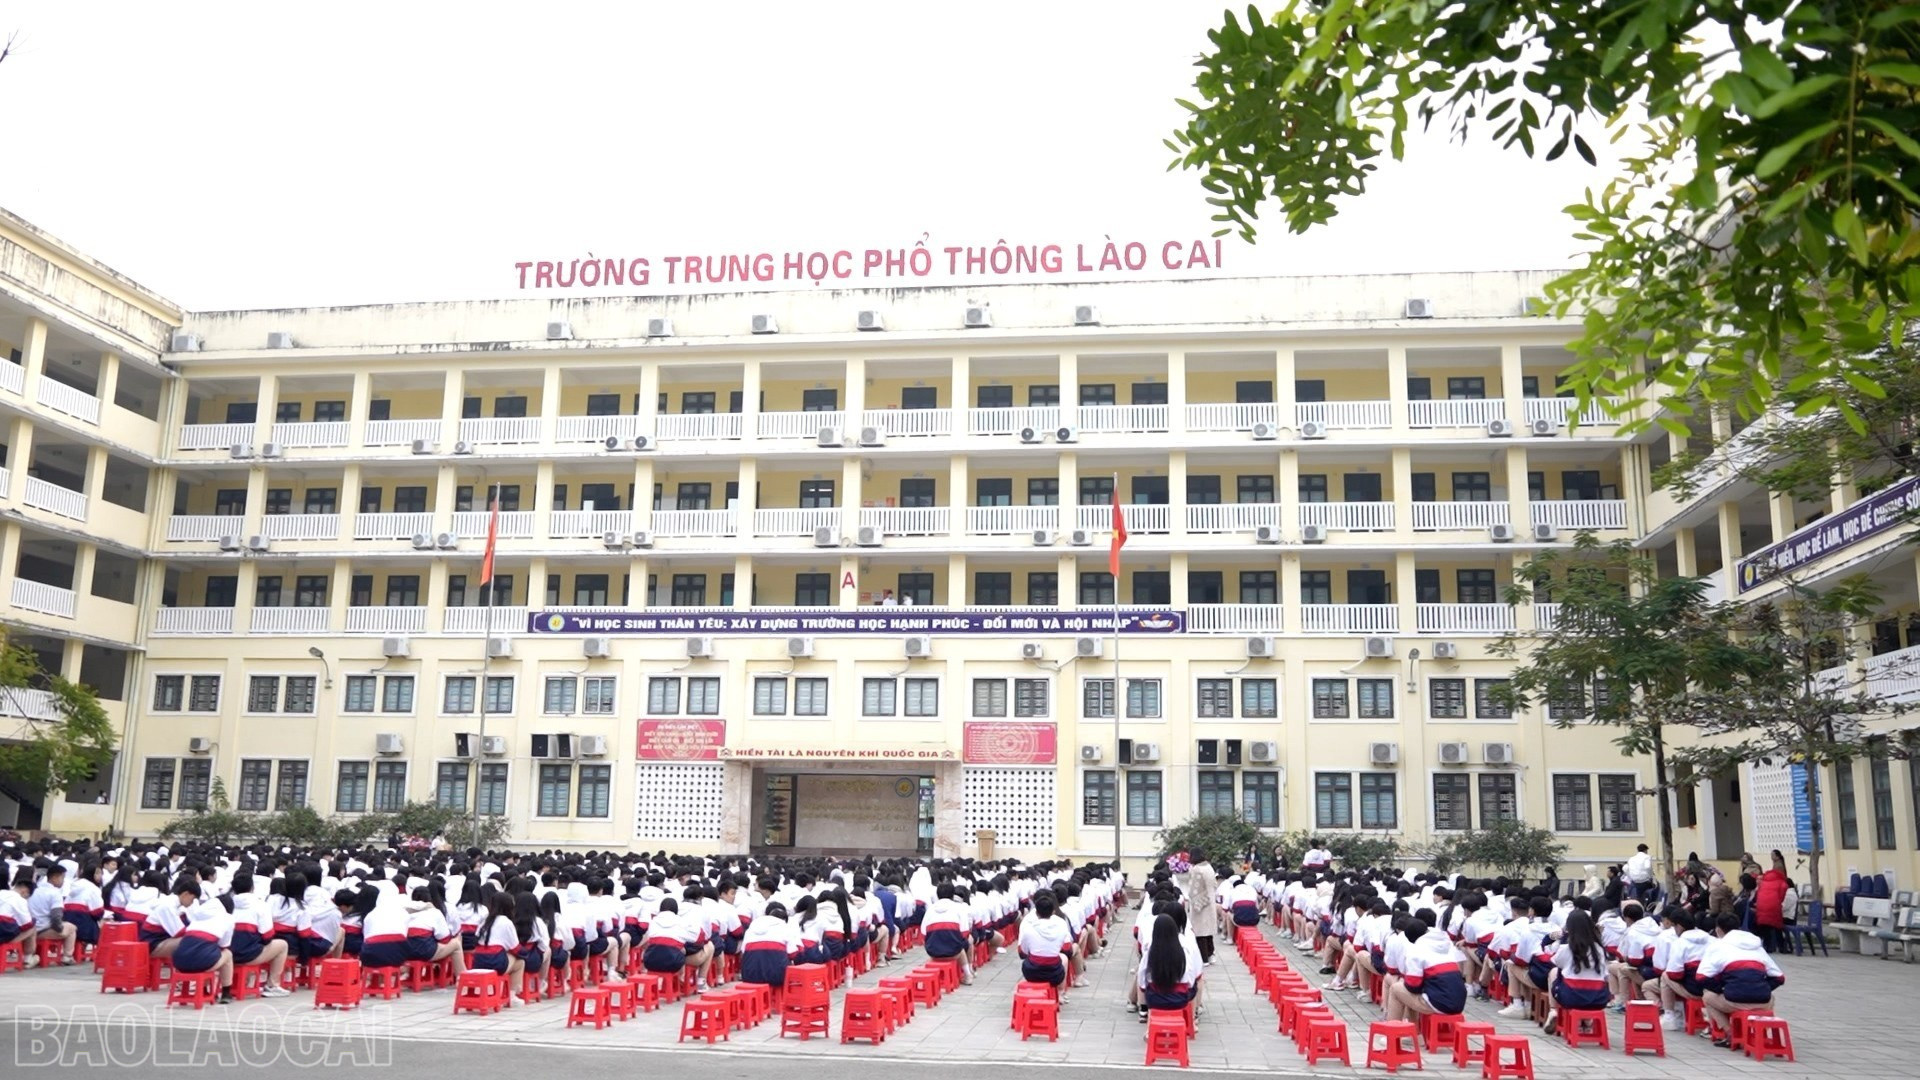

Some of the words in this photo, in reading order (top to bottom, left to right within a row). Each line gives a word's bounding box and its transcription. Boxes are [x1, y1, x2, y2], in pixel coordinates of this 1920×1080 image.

[515, 251, 649, 289] TRƯỜNG
[664, 253, 774, 284] TRUNG
[784, 250, 852, 287] HỌC
[864, 232, 932, 277] PHỔ
[944, 238, 1062, 275] THÔNG
[1077, 234, 1147, 271] LÀO
[1161, 239, 1222, 270] CAI
[1842, 517, 1860, 541] HỌC
[842, 571, 855, 588] A
[594, 619, 621, 631] HỌC
[624, 619, 657, 629] SINH
[660, 617, 695, 629] THÂN
[698, 617, 728, 629] YÊU:
[731, 617, 758, 629] XÂY
[760, 618, 798, 631] DỰNG
[802, 616, 856, 629] TRƯỜNG
[858, 619, 887, 631] HỌC
[890, 619, 929, 631] HẠNH
[932, 617, 970, 629] PHÚC
[1010, 617, 1039, 629] MỚI
[1042, 617, 1060, 629] VÀ
[1063, 617, 1088, 631] HỘI
